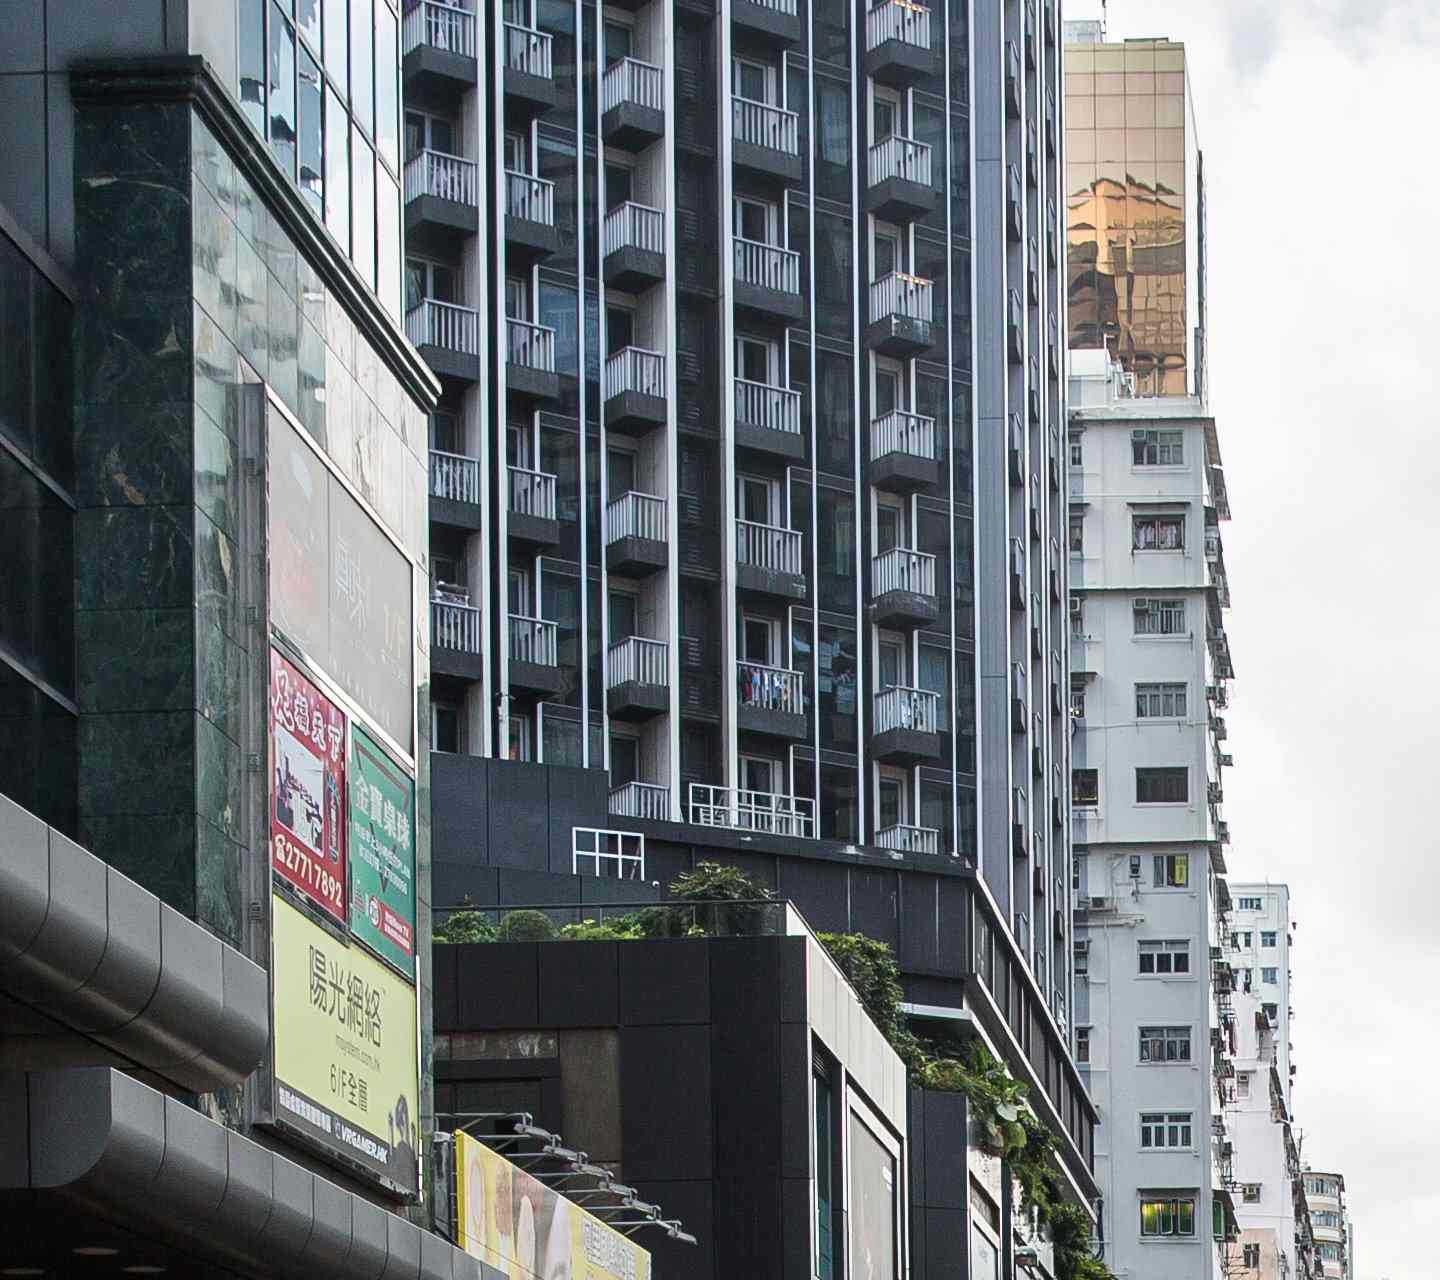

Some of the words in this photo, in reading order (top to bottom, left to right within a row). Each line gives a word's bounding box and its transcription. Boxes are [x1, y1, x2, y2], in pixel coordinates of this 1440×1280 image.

[315, 862, 343, 908] 7892
[310, 945, 382, 1048] 陽光網絡
